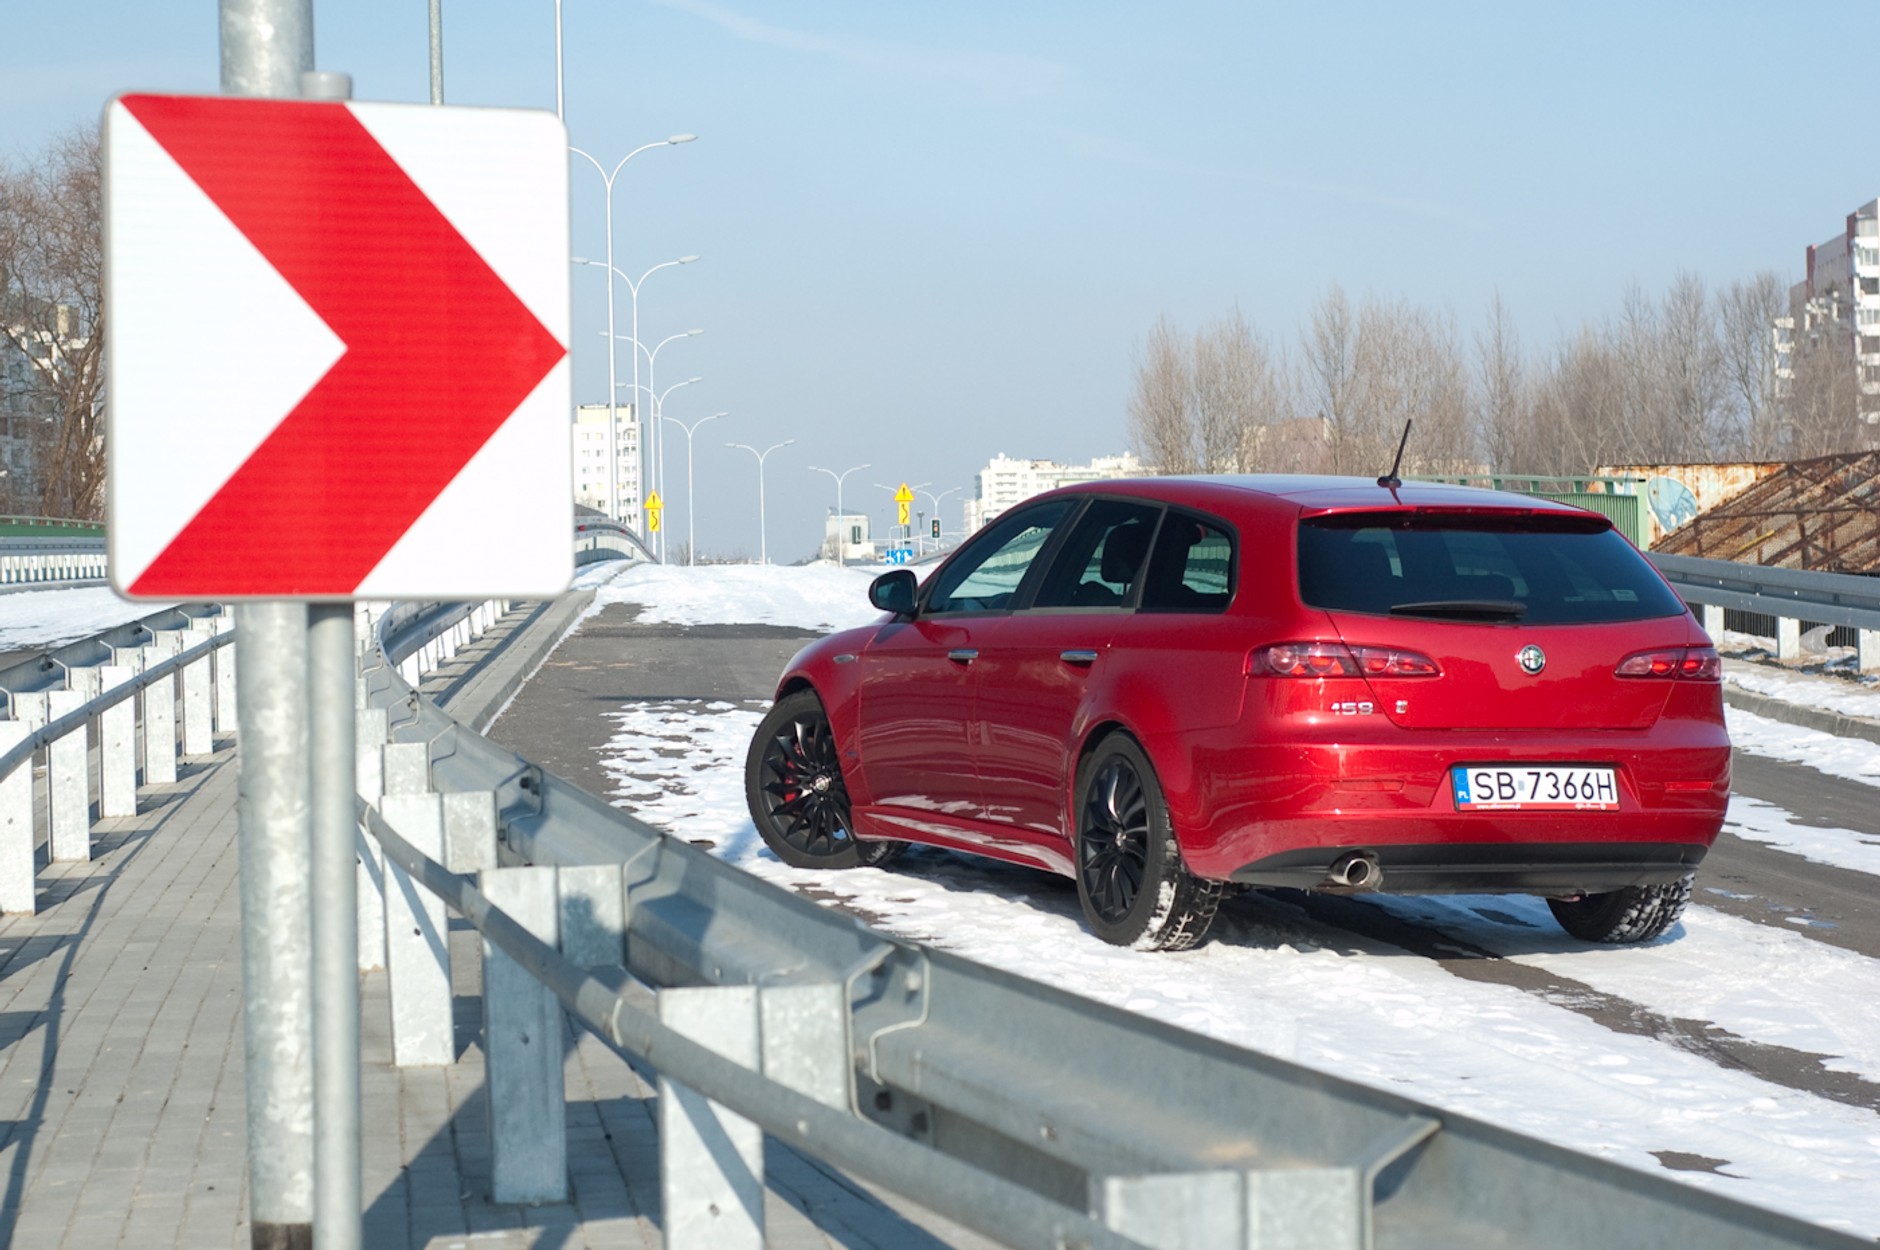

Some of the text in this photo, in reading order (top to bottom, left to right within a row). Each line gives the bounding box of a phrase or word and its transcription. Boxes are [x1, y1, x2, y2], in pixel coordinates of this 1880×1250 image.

[1331, 702, 1373, 715] 159
[1475, 771, 1614, 801] SB 7366H
[1458, 790, 1469, 799] PL
